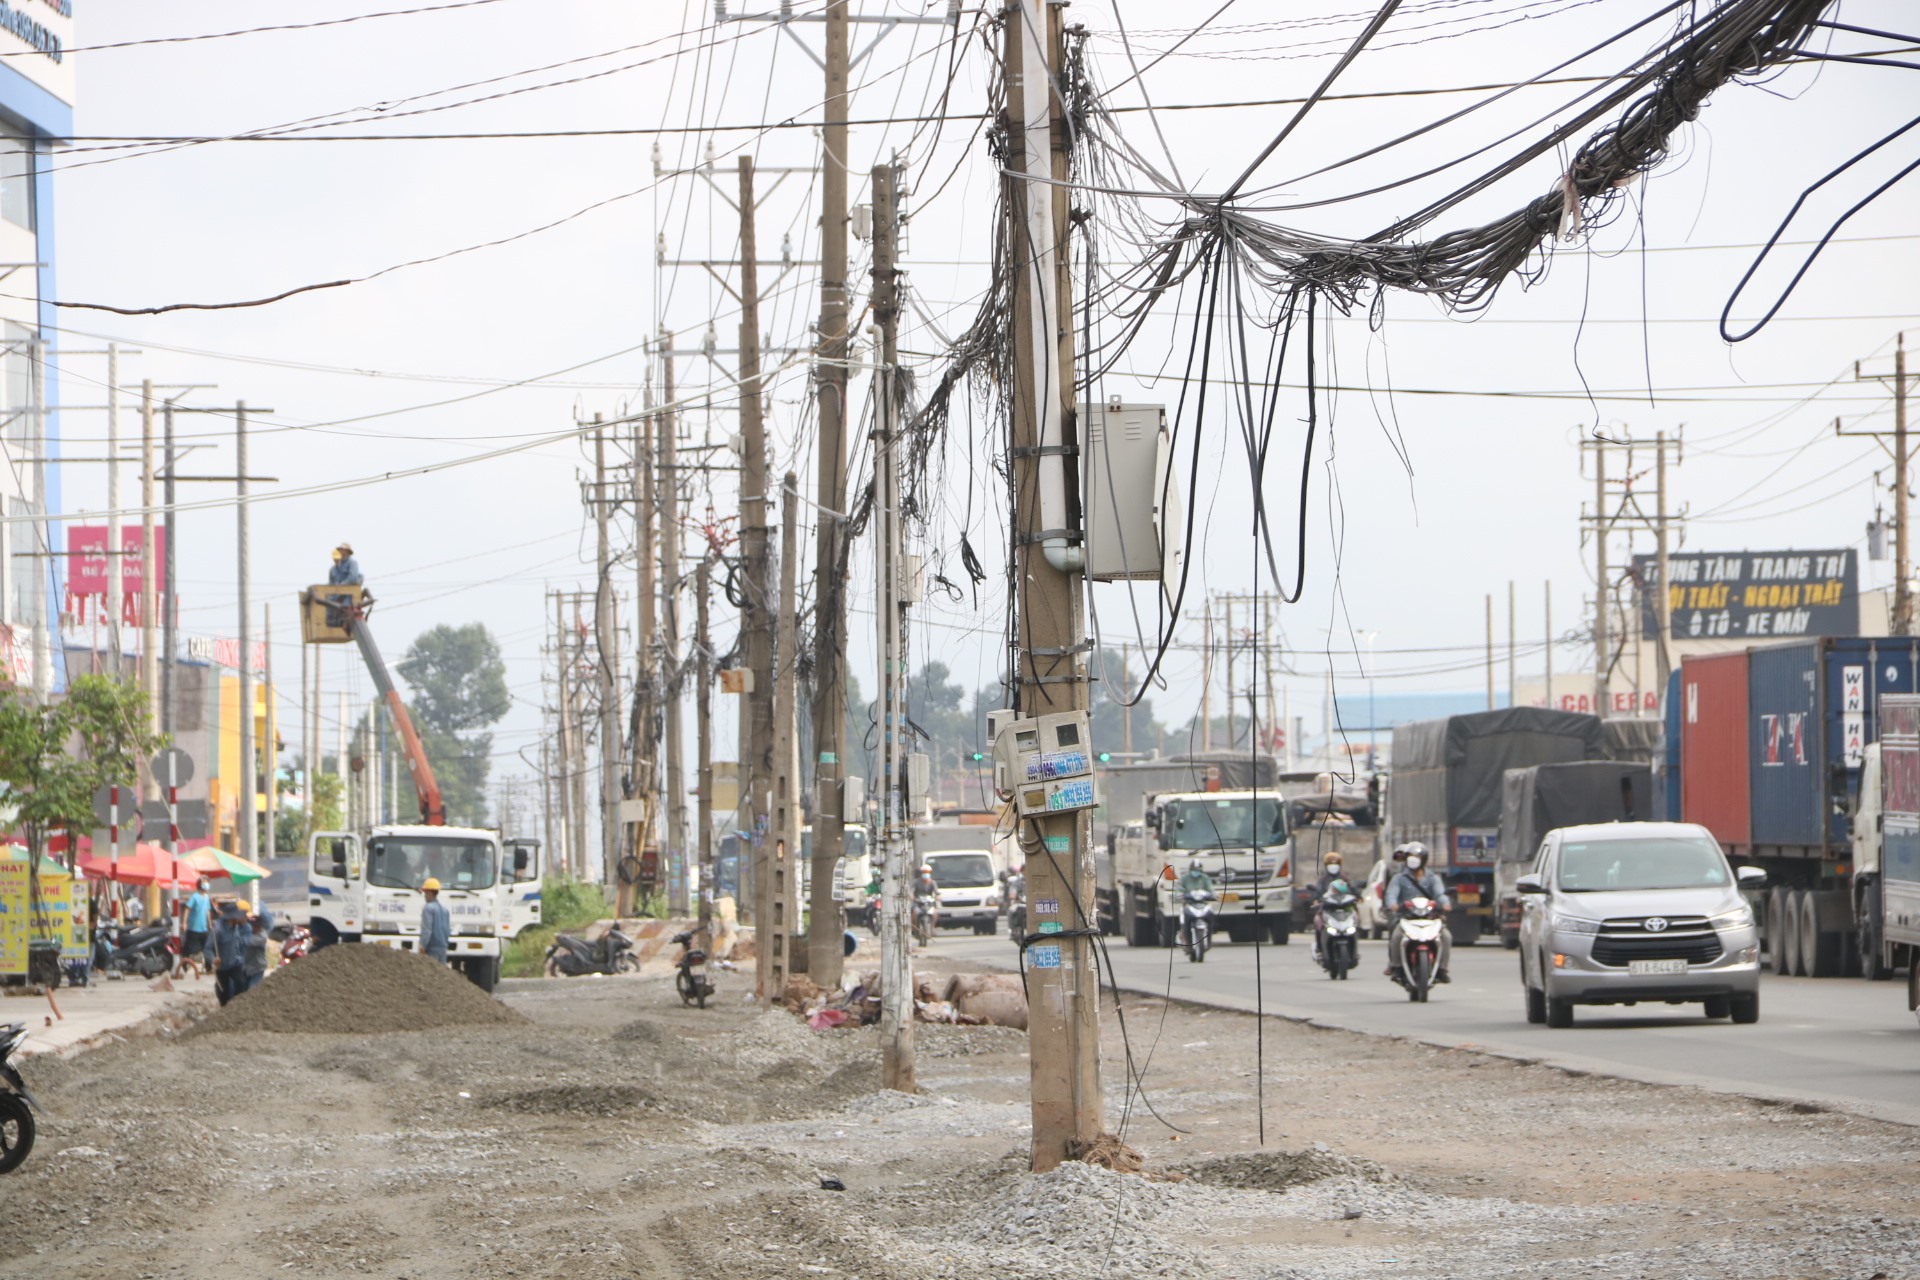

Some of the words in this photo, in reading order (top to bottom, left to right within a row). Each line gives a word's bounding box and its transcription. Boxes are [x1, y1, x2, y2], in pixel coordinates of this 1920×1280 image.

[1704, 556, 1742, 581] TÂM
[1752, 557, 1810, 580] TRANG
[1816, 552, 1847, 578] TRÍ
[1744, 584, 1800, 609] NGOẠI
[1689, 610, 1702, 636] Ô
[1707, 609, 1730, 636] TÔ
[1746, 613, 1771, 635] XE
[1773, 607, 1811, 635] MÁY
[1846, 673, 1862, 710] WAN
[1848, 723, 1860, 760] HAI
